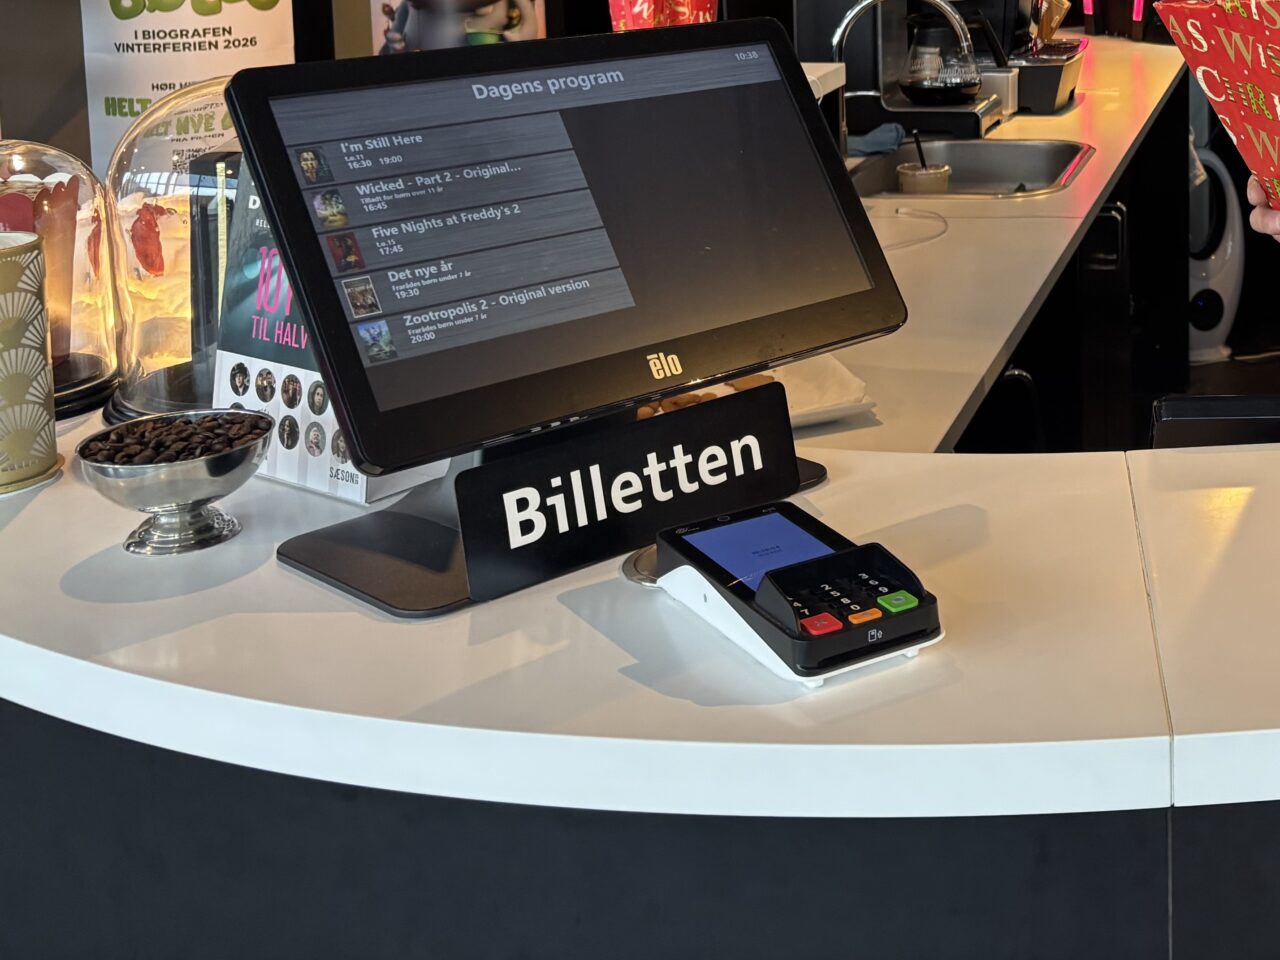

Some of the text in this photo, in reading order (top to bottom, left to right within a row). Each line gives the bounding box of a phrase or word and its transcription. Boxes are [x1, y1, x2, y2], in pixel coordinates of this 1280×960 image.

[134, 26, 233, 40] I BIOGRAFEN
[114, 36, 258, 54] VINTERFERIEN 2026
[471, 70, 625, 100] Dagens program
[340, 134, 423, 153] I'm Still Here
[347, 155, 403, 169] 16:30 19:00
[355, 178, 405, 196] Wicked
[415, 174, 442, 187] Part
[443, 172, 453, 182] 2
[363, 202, 388, 212] 16:45
[371, 204, 521, 239] Five Nights at Freddy's 2
[379, 244, 404, 255] 17:45
[387, 260, 454, 282] Det nye år
[395, 288, 420, 299] 19:30
[403, 302, 478, 327] Zootropolis
[479, 299, 488, 310] 2
[499, 286, 547, 305] Original
[548, 280, 591, 295] version
[251, 315, 270, 341] TIL
[410, 331, 436, 344] 20:00
[330, 466, 355, 484] SÆSON
[502, 434, 763, 550] Billetten
